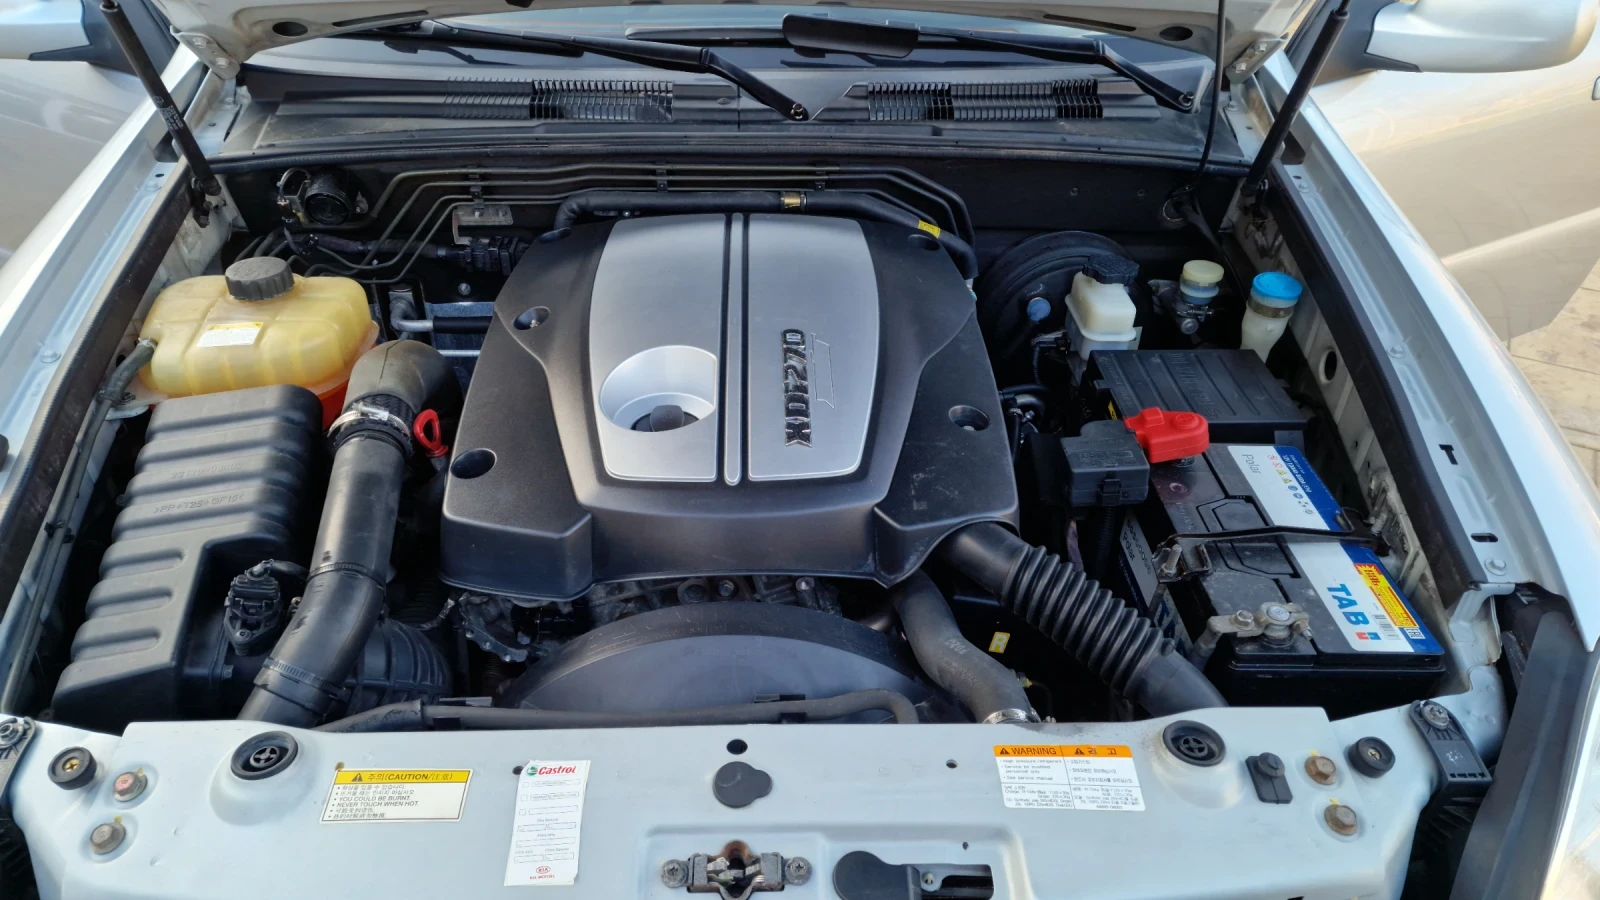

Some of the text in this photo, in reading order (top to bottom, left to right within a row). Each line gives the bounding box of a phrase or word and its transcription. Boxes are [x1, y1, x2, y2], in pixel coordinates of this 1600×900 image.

[1242, 454, 1262, 474] Polar
[1327, 583, 1370, 626] TAB
[992, 634, 1006, 652] R
[539, 766, 576, 775] Castrol
